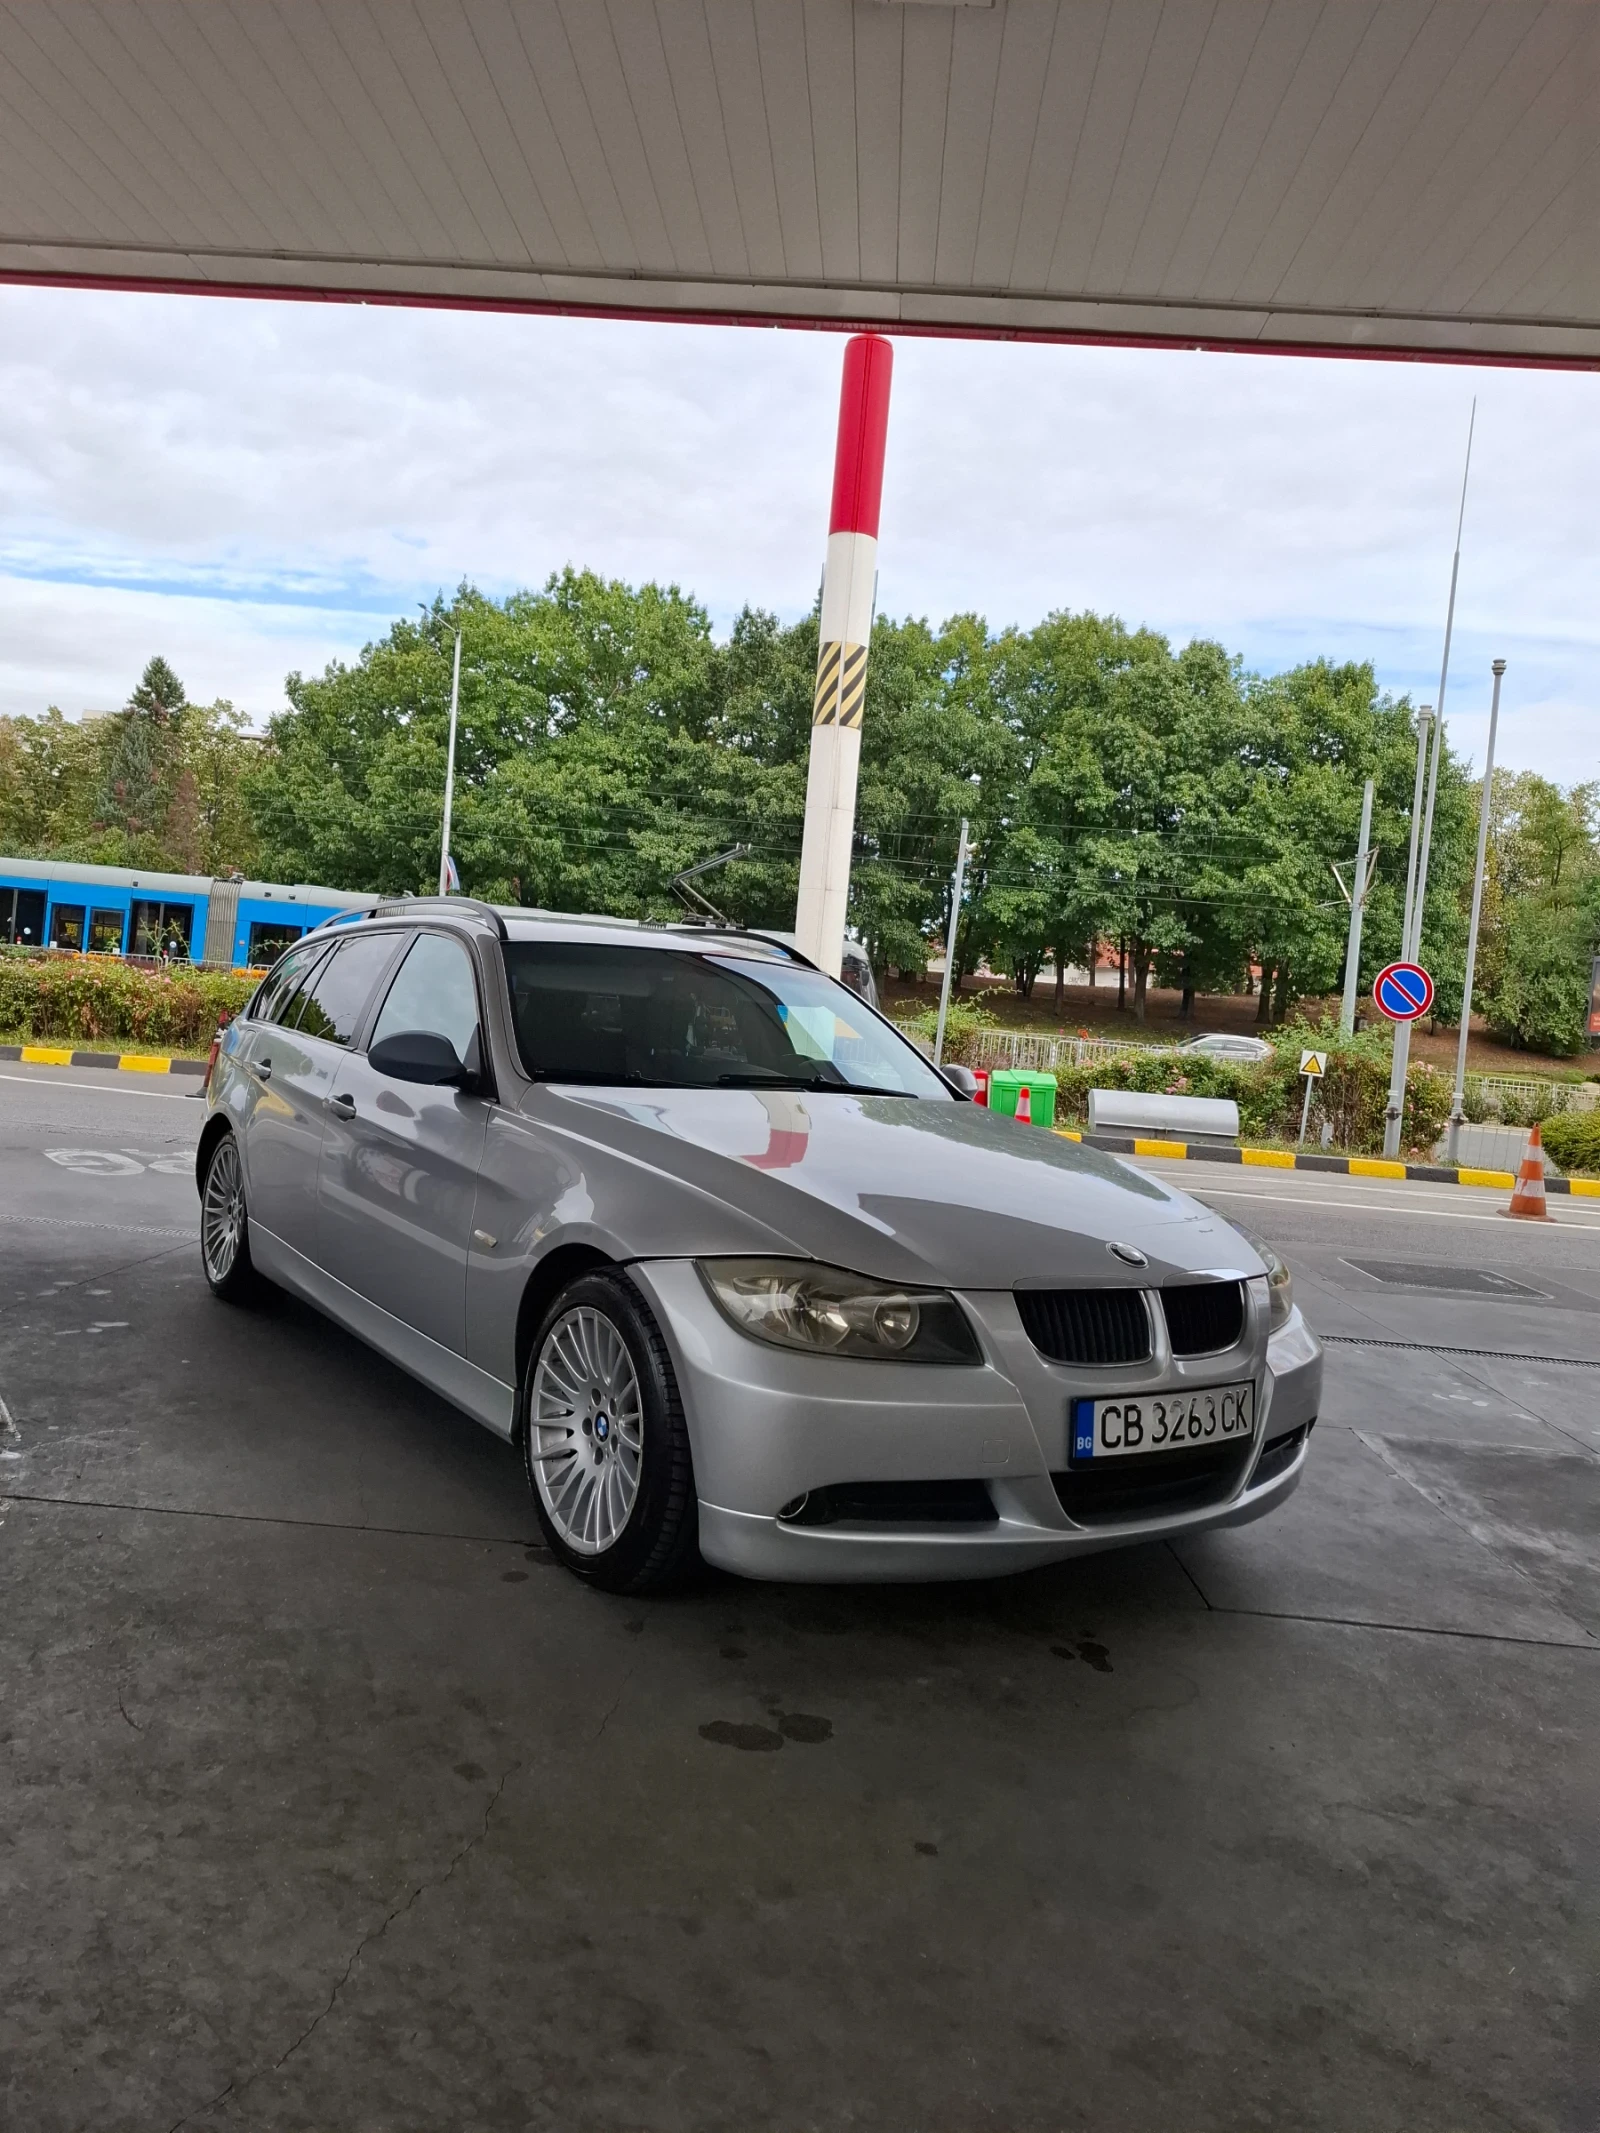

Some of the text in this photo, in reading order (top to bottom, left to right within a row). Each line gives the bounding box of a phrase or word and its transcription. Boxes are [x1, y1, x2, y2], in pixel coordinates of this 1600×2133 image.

[1101, 1388, 1248, 1449] CB 3263 CK
[1077, 1437, 1092, 1450] BG
